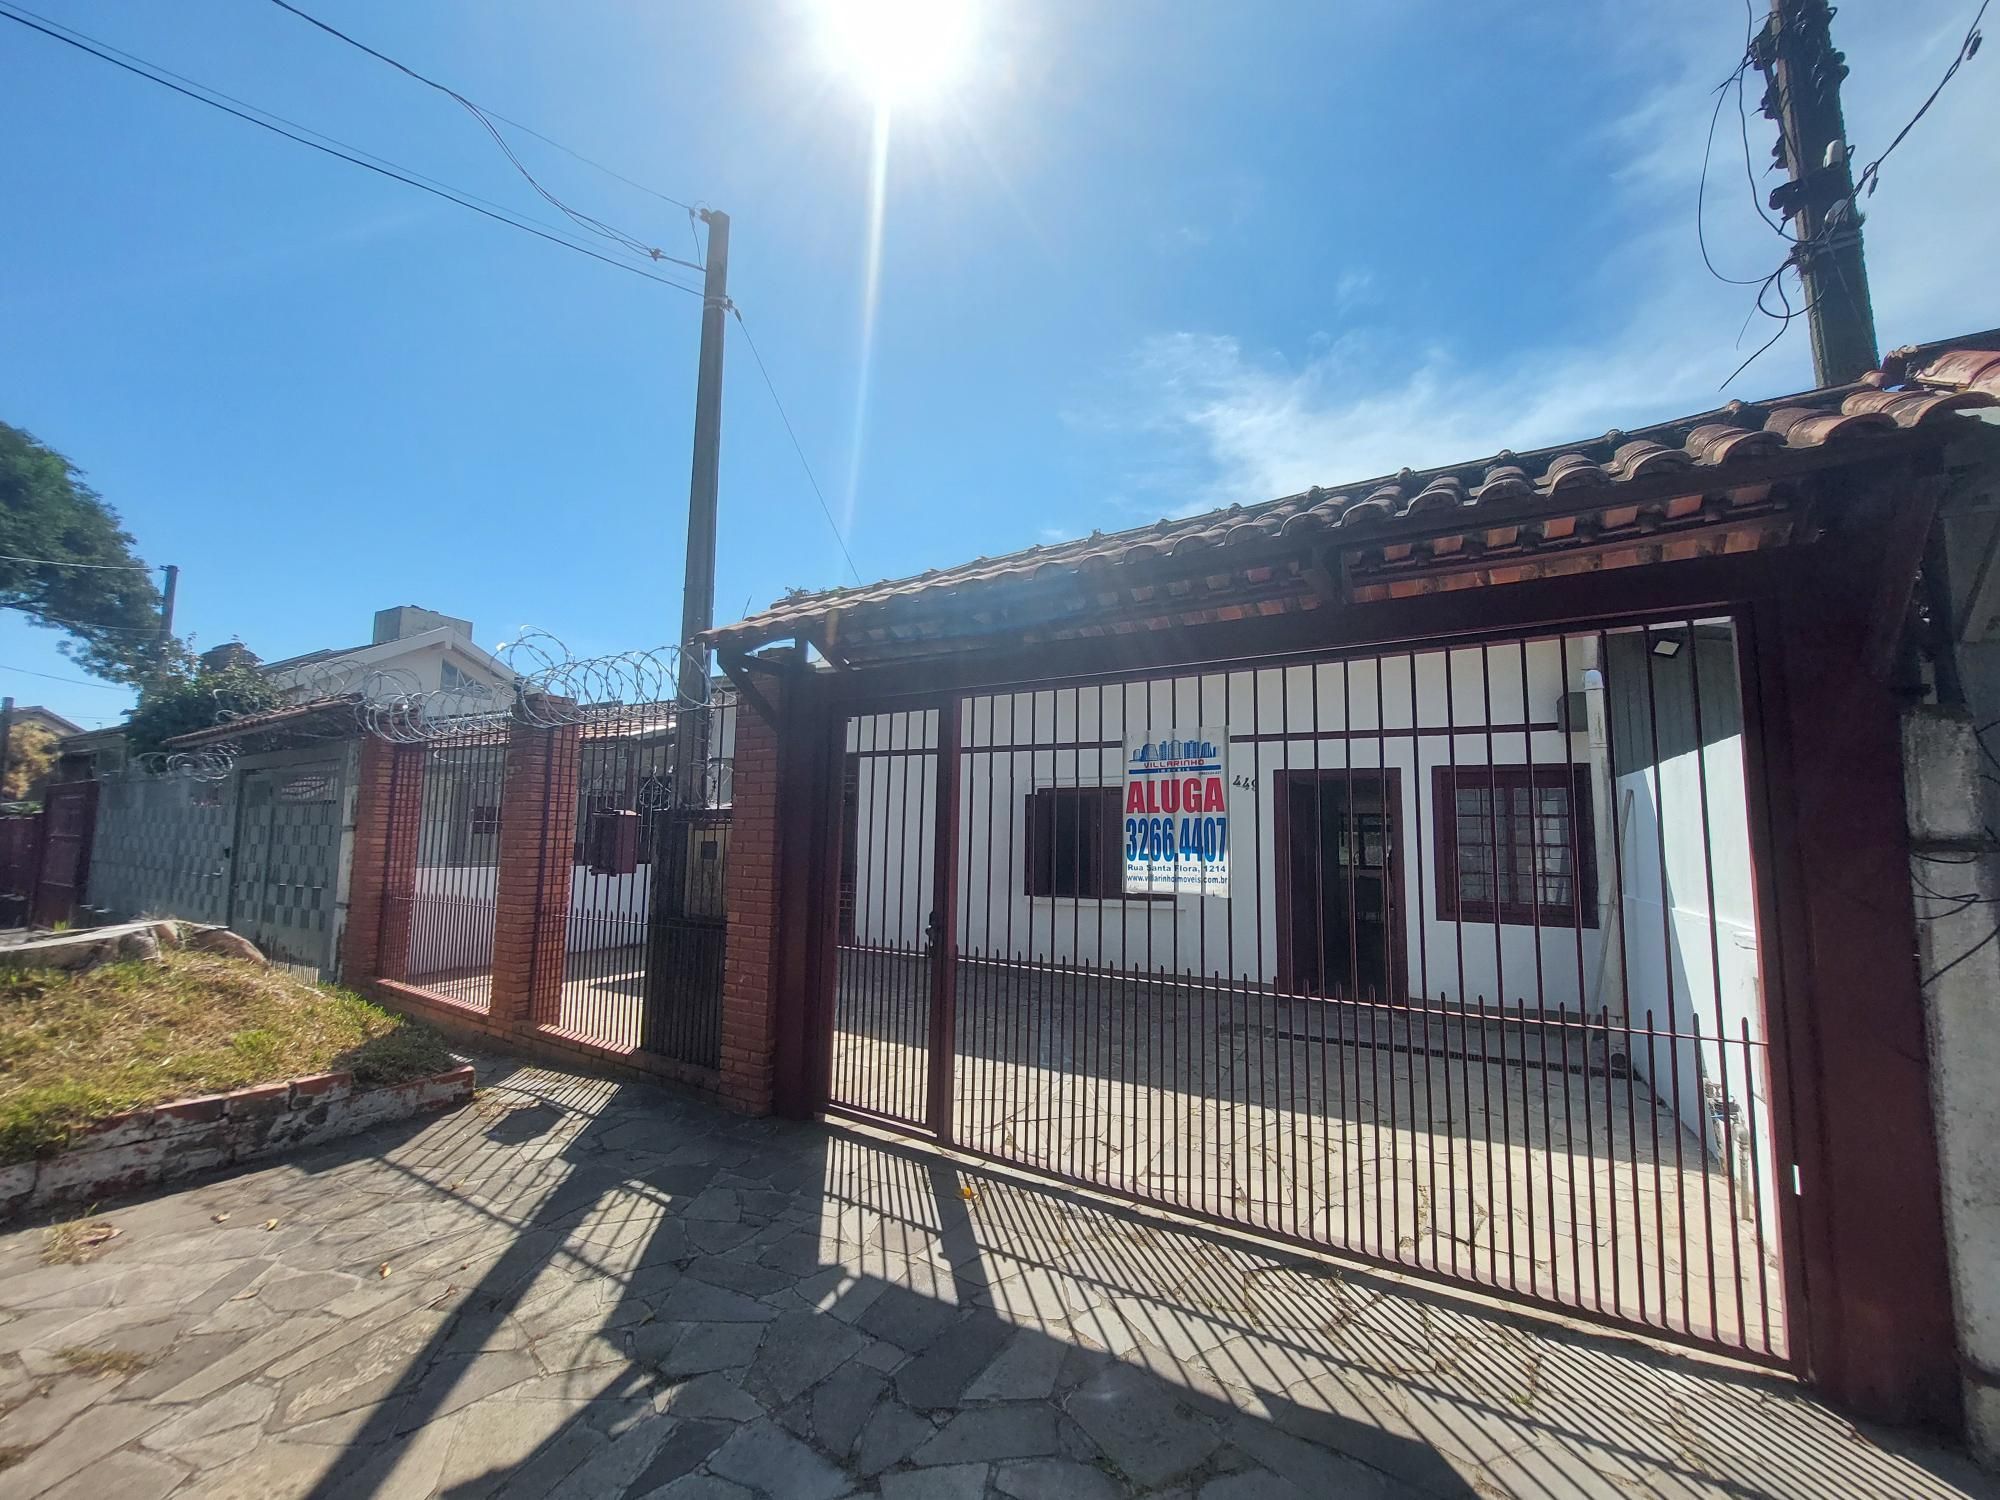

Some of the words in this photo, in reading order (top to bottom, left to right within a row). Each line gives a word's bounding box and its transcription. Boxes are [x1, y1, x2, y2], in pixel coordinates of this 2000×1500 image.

[1143, 759, 1205, 769] VILLARINHO
[1126, 777, 1225, 814] ALUGA
[1126, 817, 1226, 862] 3266.4407
[1147, 864, 1172, 872] Santa
[1174, 864, 1201, 873] Flora,
[1203, 865, 1226, 873] 1214
